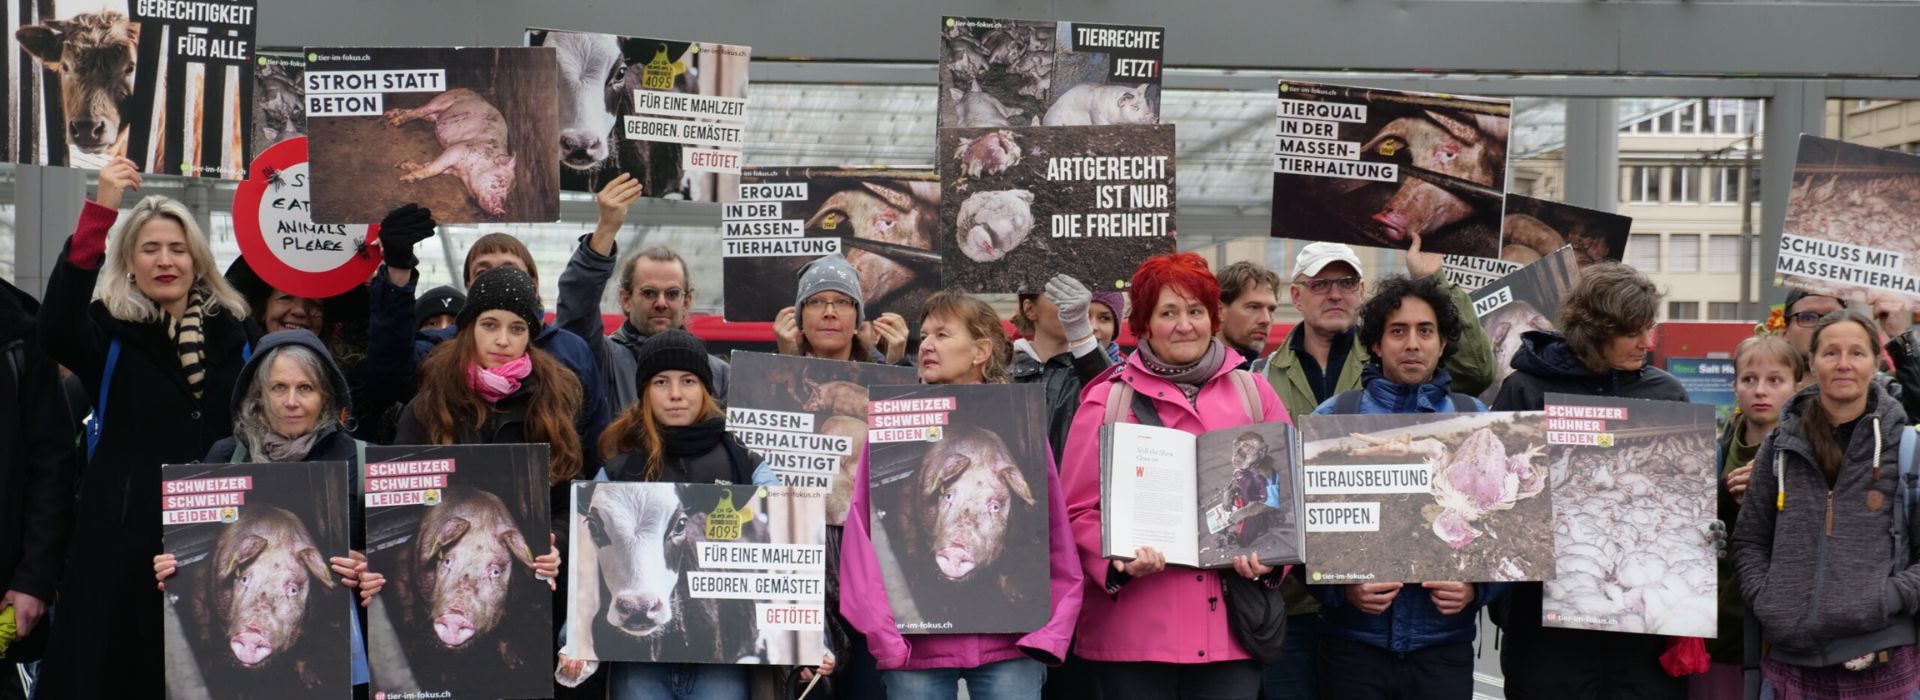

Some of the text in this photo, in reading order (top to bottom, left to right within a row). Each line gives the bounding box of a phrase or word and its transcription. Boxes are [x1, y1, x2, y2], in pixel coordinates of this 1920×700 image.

[137, 0, 254, 25] GERECHTIGKEIT
[177, 34, 207, 57] FÜR
[1077, 27, 1161, 49] TIERRECHTE
[1114, 58, 1159, 78] JETZT!
[308, 72, 440, 91] STROH STATT
[644, 76, 672, 89] 4095
[310, 96, 377, 113] BETON
[639, 92, 745, 116] FÜR EINE MAHLZEIT
[1281, 101, 1362, 120] TIERQUAL
[627, 120, 742, 143] GEBOREN. GEMÄSTET.
[1280, 120, 1333, 136] IN DER
[1280, 139, 1356, 156] MASSEN-
[691, 151, 740, 169] GETÖTET.
[1047, 156, 1168, 181] ARTGERECHT
[1279, 157, 1394, 179] TIERHALTUNG
[740, 186, 804, 199] ERQUAL
[1096, 184, 1168, 209] IST NUR
[726, 205, 778, 218] IN DER
[727, 222, 800, 236] MASSEN-
[1051, 214, 1082, 238] DIE
[727, 240, 837, 254] TIERHALTUNG
[1780, 236, 1900, 269] SCHLUSS MIT
[1475, 290, 1509, 315] NDE
[873, 399, 951, 413] SCHWEIZER
[1549, 406, 1622, 418] SCHWEIZER
[730, 410, 809, 429] MASSEN-
[875, 414, 944, 427] SCHWEINE
[1549, 418, 1600, 431] HÜHNER
[876, 429, 922, 442] LEIDEN
[1550, 433, 1594, 443] LEIDEN
[369, 461, 450, 476] SCHWEIZER
[167, 478, 247, 494] SCHWEIZER
[371, 476, 441, 491] SCHWEINE
[1306, 469, 1428, 488] TIERAUSBEUTUNG
[168, 493, 239, 508] SCHWEINE
[371, 492, 420, 506] LEIDEN
[169, 510, 217, 523] LEIDEN
[1308, 507, 1375, 525] STOPPEN.
[708, 525, 738, 539] 4095
[704, 544, 823, 564] FÜR EINE MAHLZEIT
[692, 576, 822, 595] GEBOREN. GEMÄSTET.
[766, 606, 822, 625] GETÖTET.
[387, 690, 451, 700] tier-im-fokus.ch
